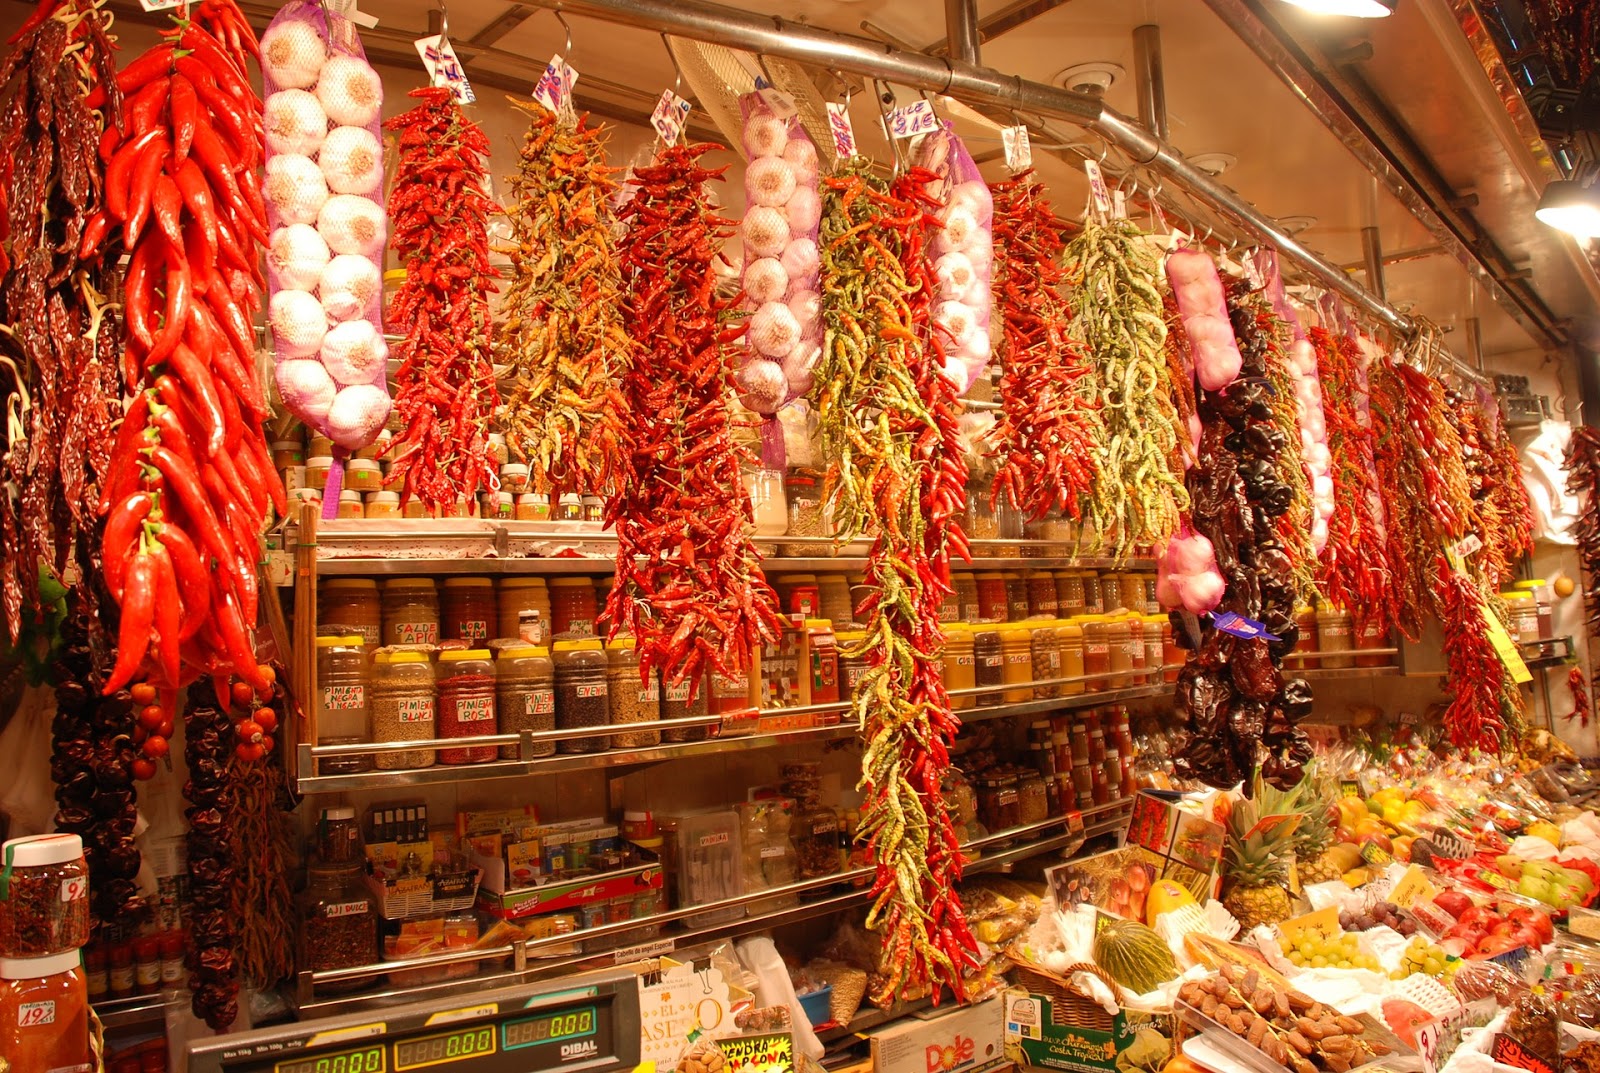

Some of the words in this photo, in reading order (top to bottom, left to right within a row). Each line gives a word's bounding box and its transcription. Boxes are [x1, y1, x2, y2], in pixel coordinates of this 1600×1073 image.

[330, 694, 358, 702] NEGRA
[464, 709, 490, 720] ROSA
[371, 1027, 381, 1035] kg
[550, 1011, 591, 1038] 0.00
[447, 1030, 491, 1057] 0.00
[560, 1040, 597, 1057] DIBAL
[1049, 1045, 1072, 1056] Costa
[925, 1035, 975, 1073] Dole
